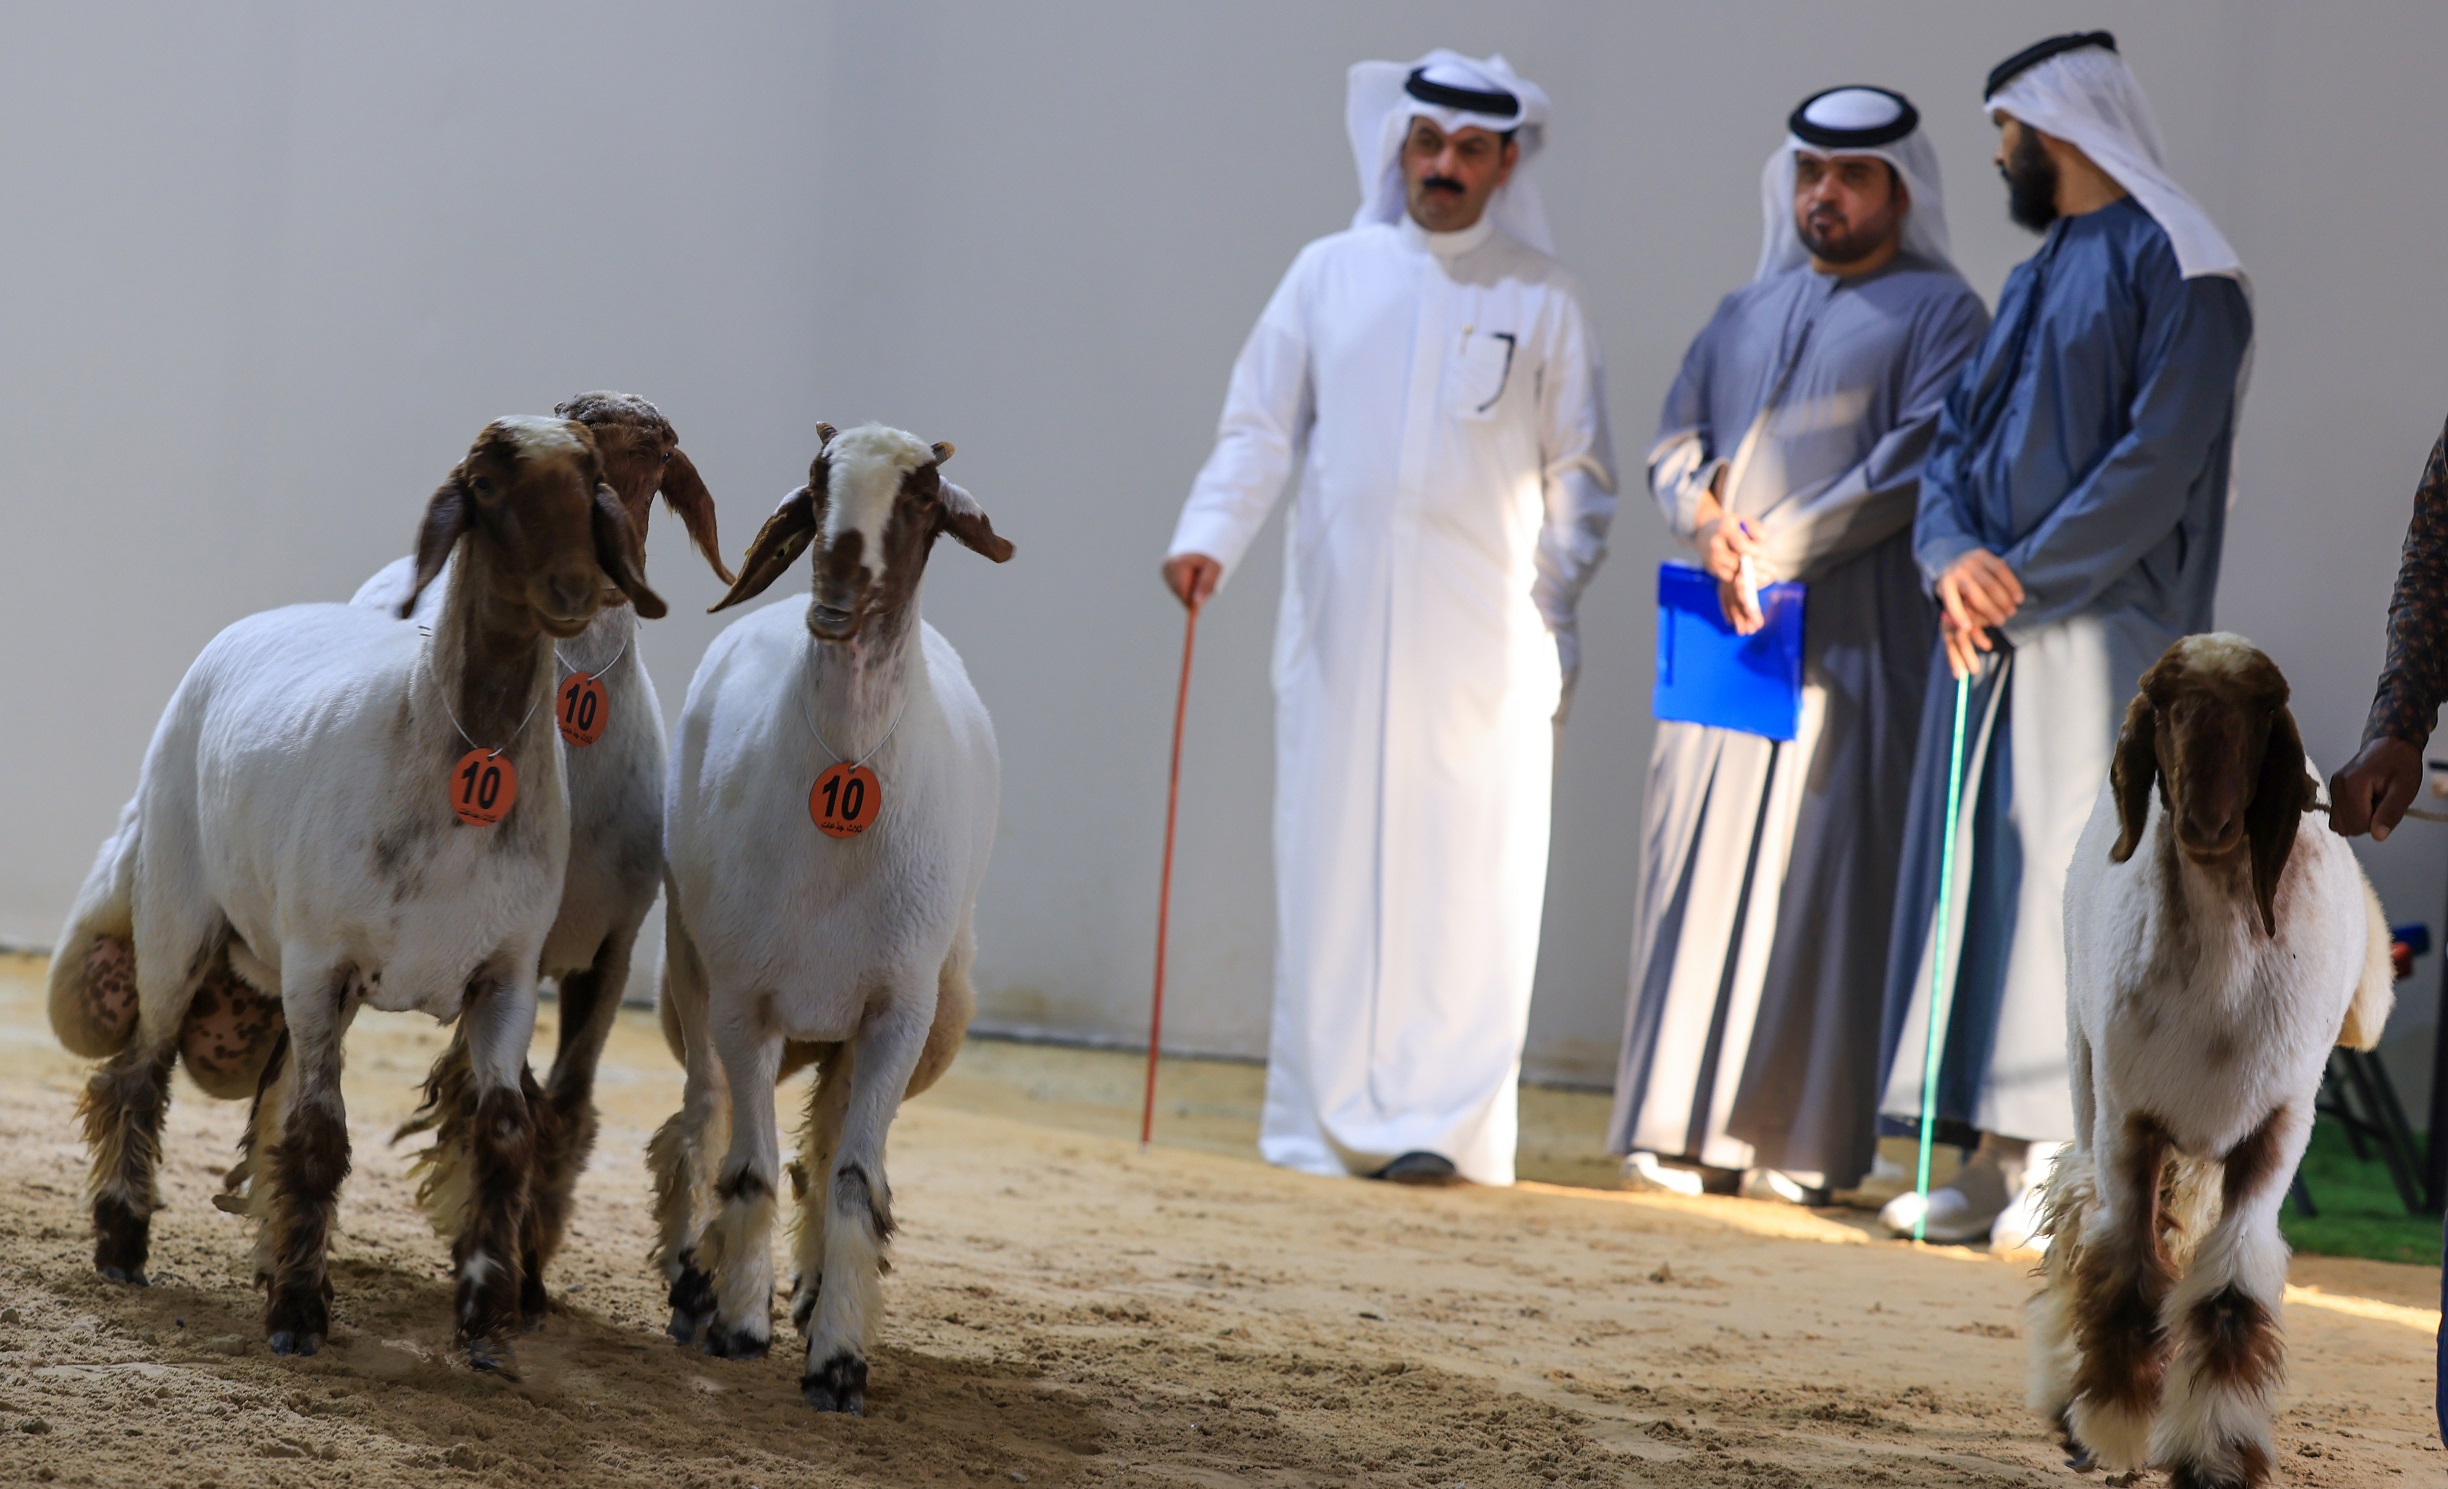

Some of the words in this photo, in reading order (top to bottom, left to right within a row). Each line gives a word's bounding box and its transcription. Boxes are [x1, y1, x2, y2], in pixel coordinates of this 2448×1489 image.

[566, 683, 597, 731] 10
[461, 760, 501, 809] 10
[823, 775, 864, 820] 10
[847, 824, 863, 833] ثلاث
